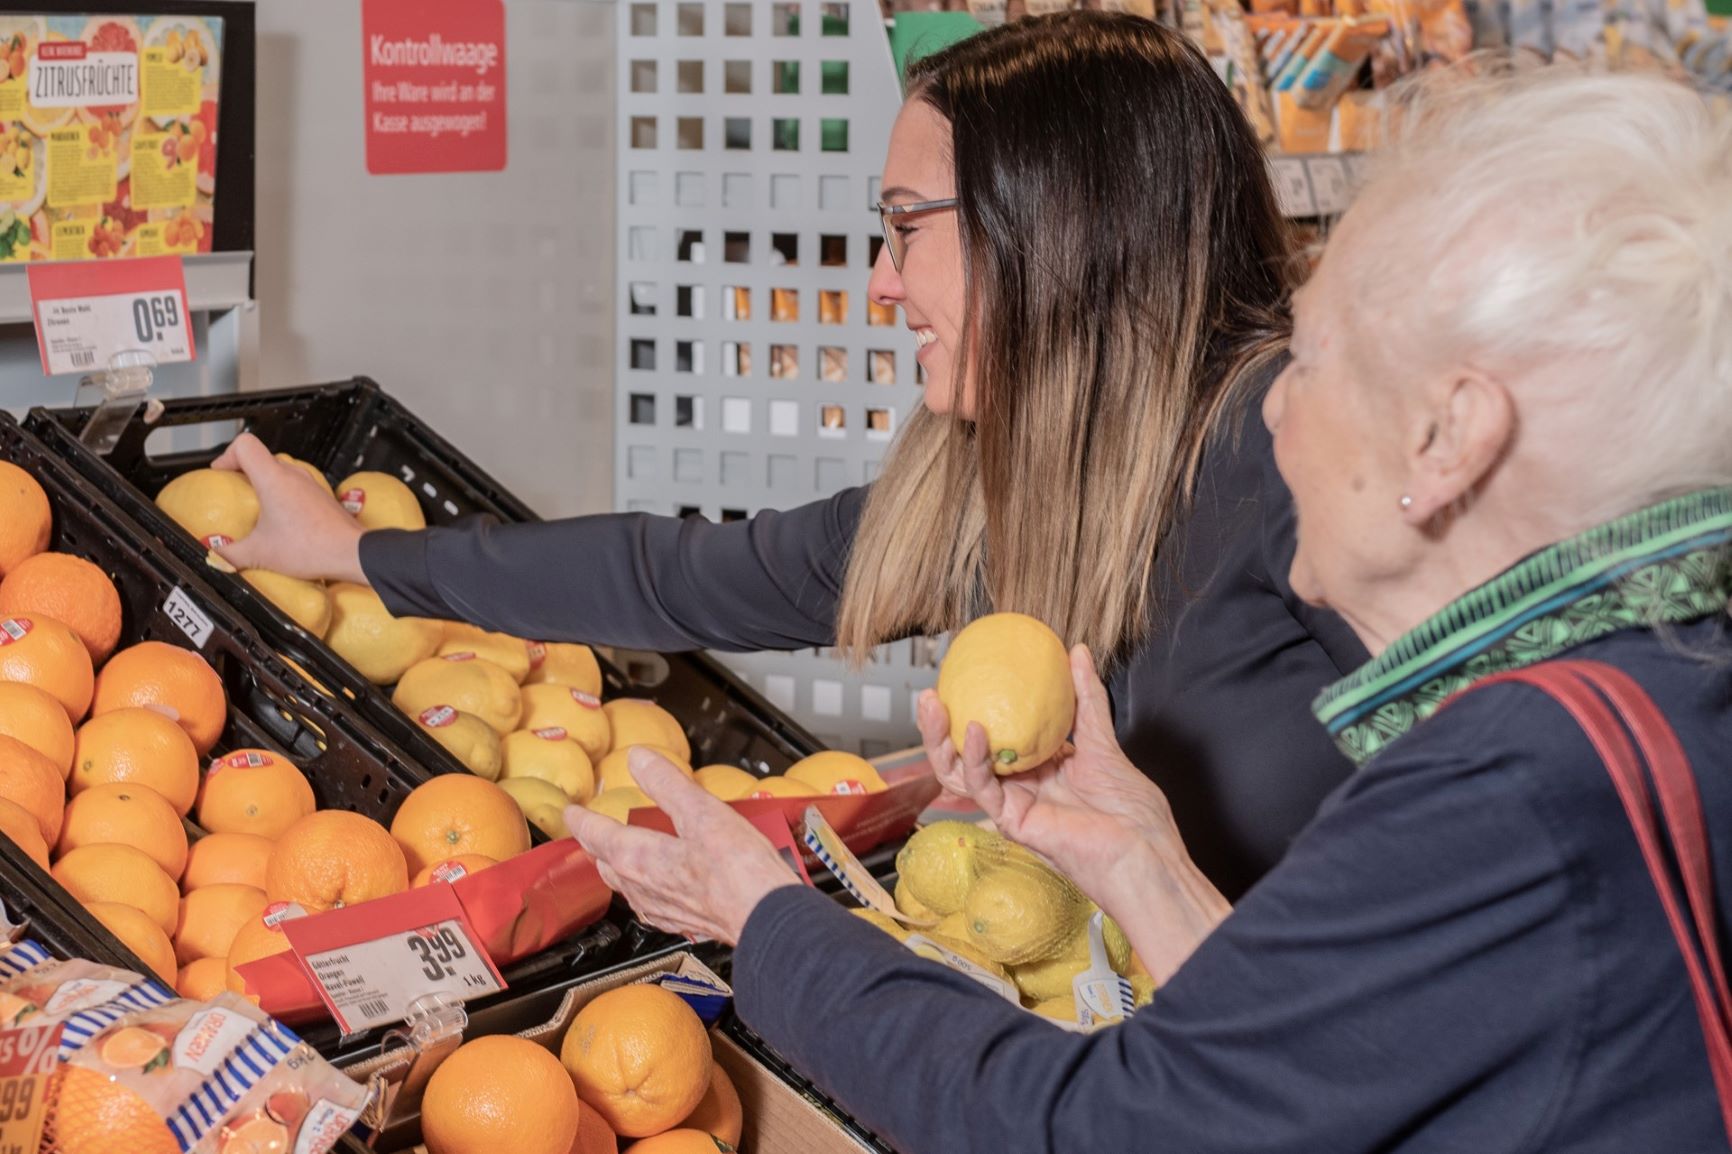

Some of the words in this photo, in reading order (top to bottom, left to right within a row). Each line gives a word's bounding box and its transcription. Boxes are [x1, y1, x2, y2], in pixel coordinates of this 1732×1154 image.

[371, 33, 498, 74] Kontrollwaage
[35, 59, 134, 98] ZITRUSFRÜCHTE
[372, 80, 396, 102] Ihre
[397, 81, 429, 102] Ware
[430, 80, 457, 102] wird
[459, 85, 474, 102] an
[477, 80, 496, 102] der
[373, 112, 408, 133] Kasse
[169, 601, 201, 637] 1277
[469, 973, 487, 986] kg
